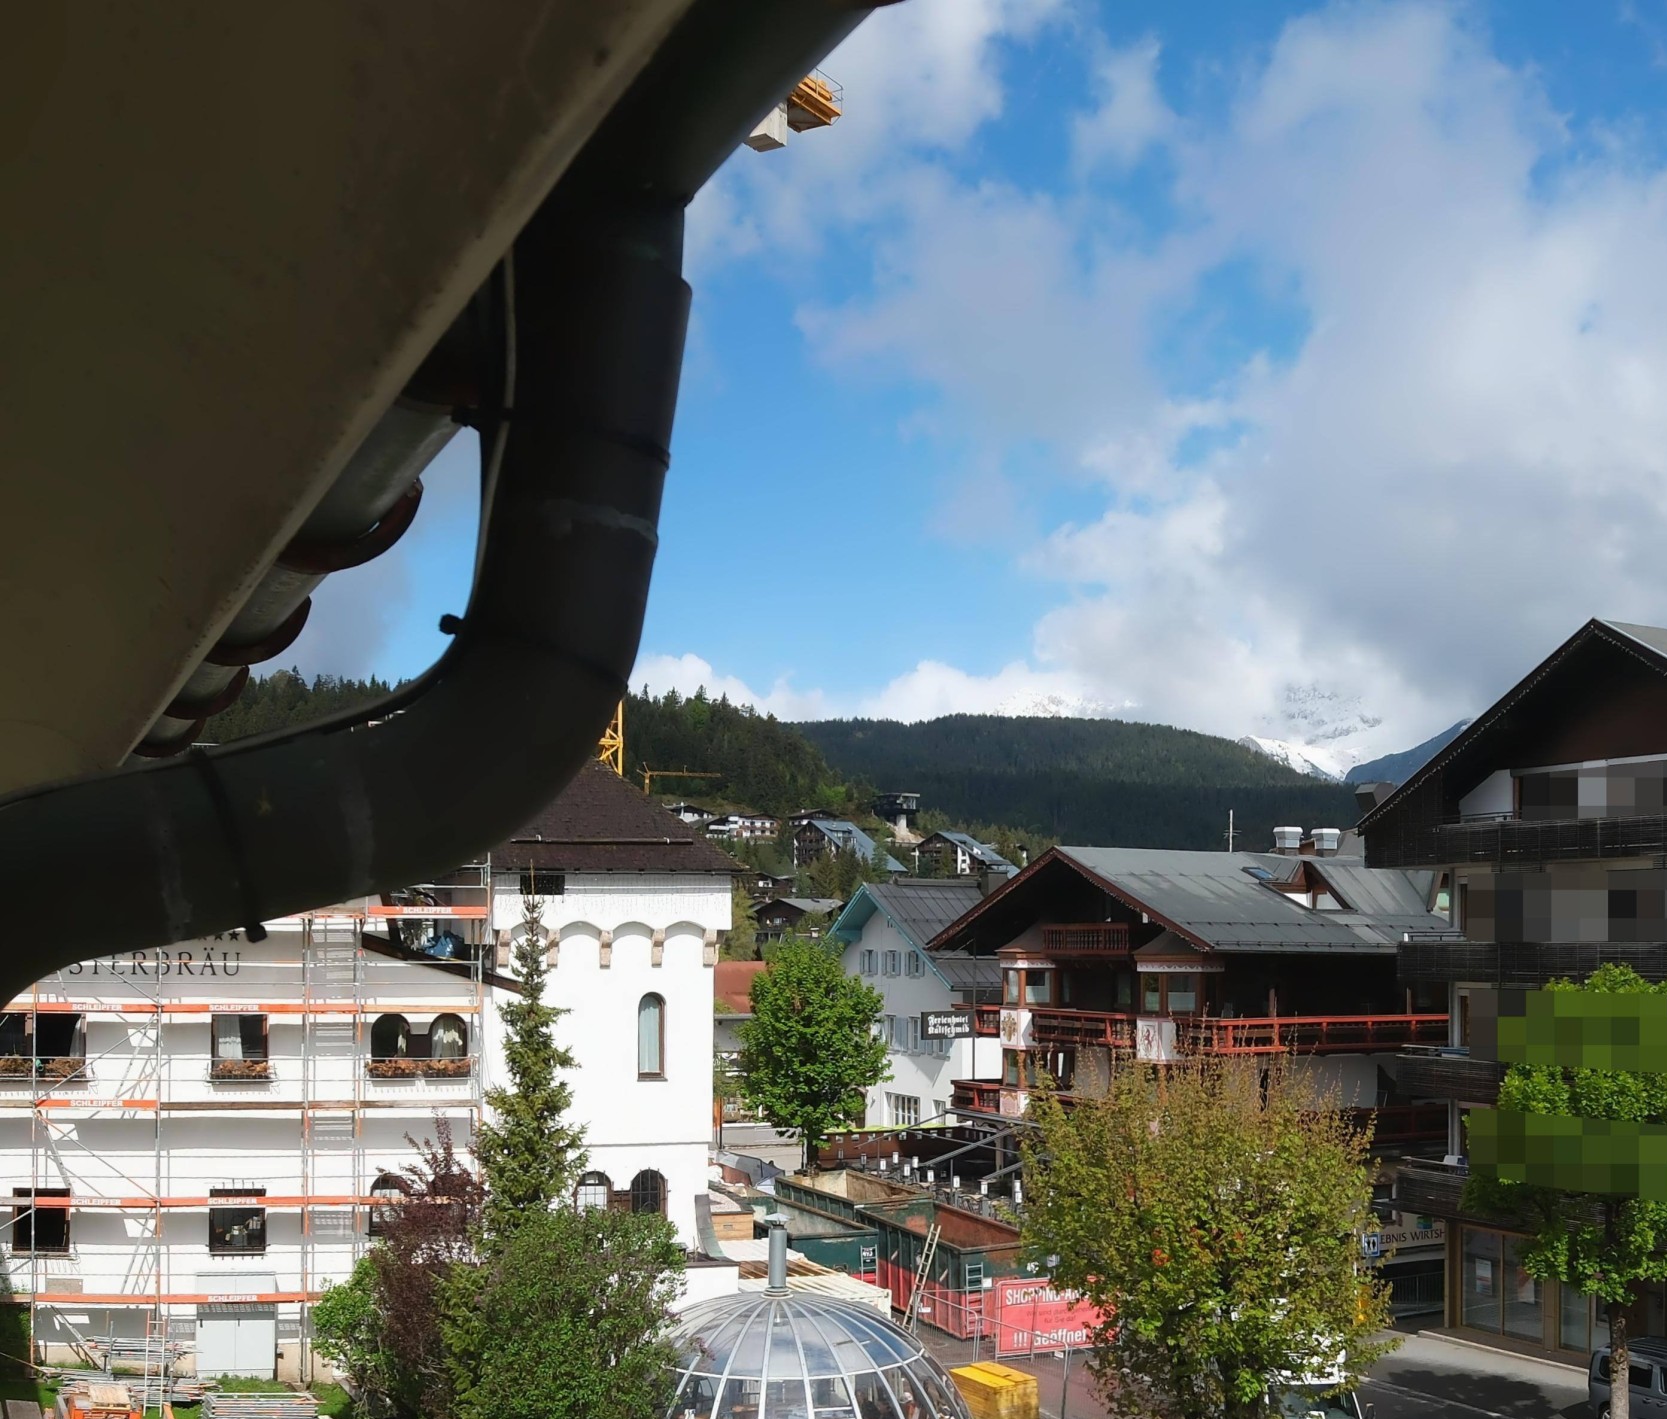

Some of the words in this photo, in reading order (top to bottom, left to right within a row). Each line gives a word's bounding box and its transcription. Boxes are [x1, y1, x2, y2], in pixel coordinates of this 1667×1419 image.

[69, 947, 242, 976] STERBRÄU
[72, 1003, 123, 1011] SCHLEIPFER
[209, 1003, 259, 1011] SCHLEIPFER
[71, 1198, 122, 1206] SCHLEIPFER
[1380, 1232, 1407, 1245] EBNIS
[1034, 1328, 1087, 1346] Geöffnet
